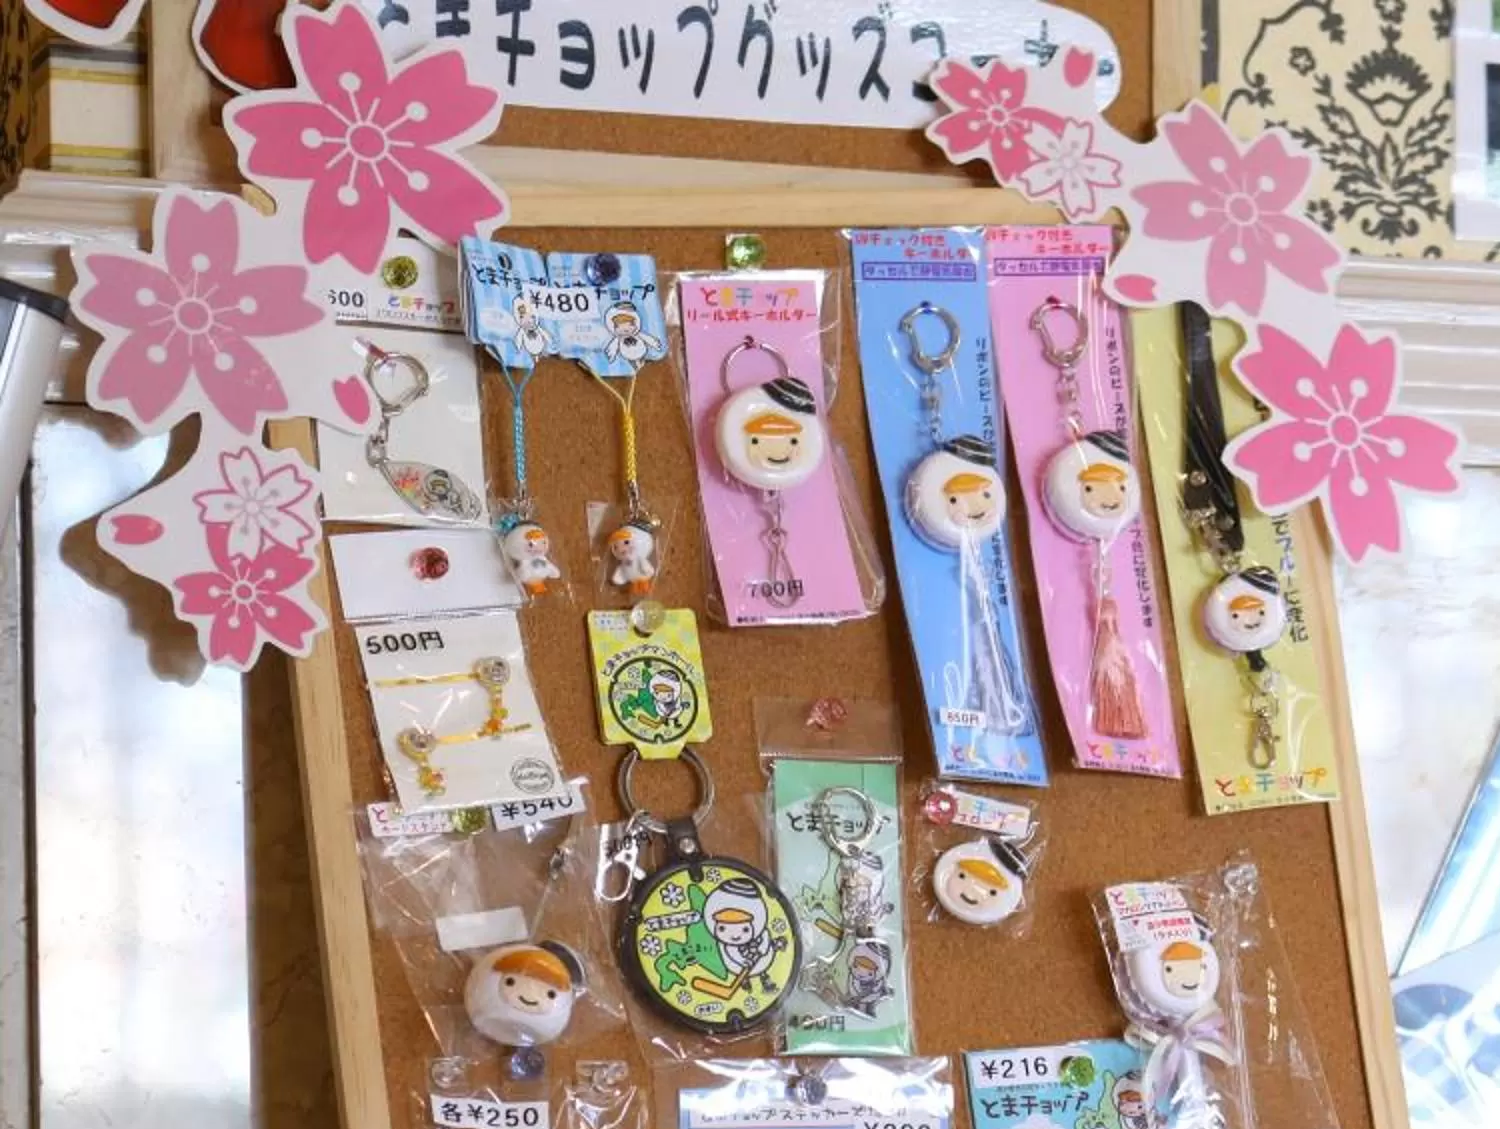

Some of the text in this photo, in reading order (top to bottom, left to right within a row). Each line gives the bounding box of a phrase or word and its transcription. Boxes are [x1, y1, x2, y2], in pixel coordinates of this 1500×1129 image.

[529, 289, 589, 313] ¥480
[366, 630, 445, 656] 500円
[981, 1055, 1049, 1081] ¥216
[440, 1103, 540, 1128] 各¥250
[980, 1091, 1090, 1119] とまチョップ
